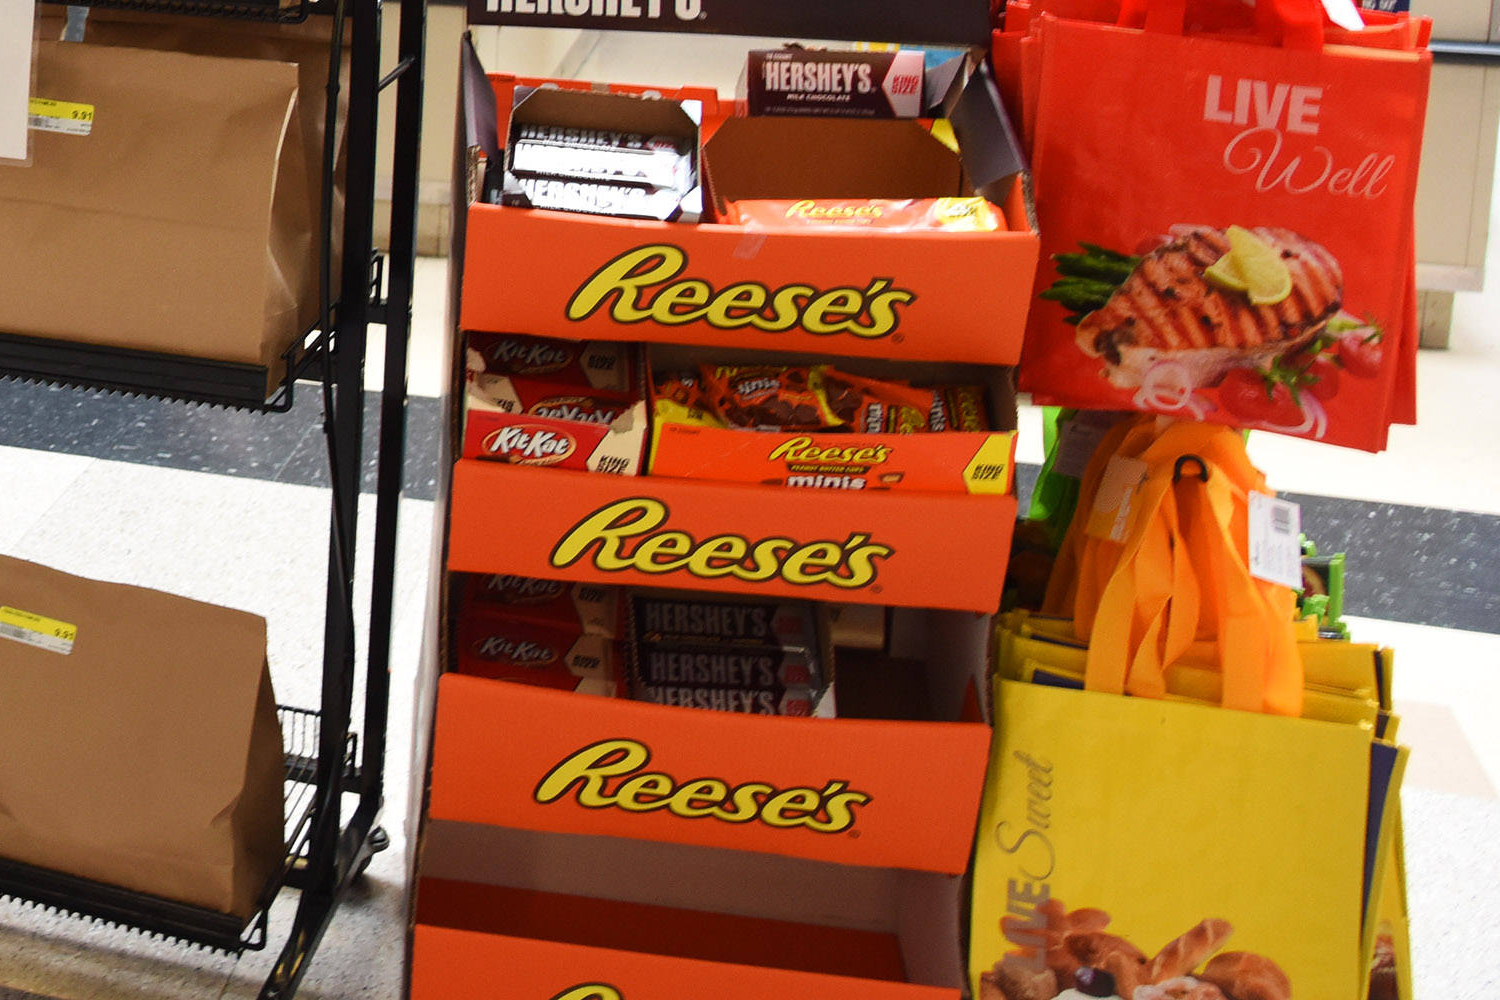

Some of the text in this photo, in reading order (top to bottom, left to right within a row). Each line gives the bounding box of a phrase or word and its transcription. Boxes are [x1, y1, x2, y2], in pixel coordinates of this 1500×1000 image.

[766, 62, 872, 94] HERSHEY'S
[891, 75, 919, 86] KING
[786, 93, 851, 103] MILK CHOCOLATE
[891, 85, 918, 95] SIZE
[72, 110, 93, 120] 9.91
[1203, 74, 1323, 136] LIVE
[520, 125, 642, 148] HERSHEY'S
[1222, 125, 1397, 200] Well
[785, 199, 883, 219] Reese's
[566, 242, 918, 339] Reese's
[599, 455, 629, 467] KING
[768, 436, 893, 464] Reese's
[790, 465, 817, 473] PEANUT
[844, 466, 864, 474] CUPS
[971, 471, 1003, 482] SIZE
[975, 463, 1005, 474] KING
[786, 473, 866, 491] minis
[550, 496, 895, 590] Reese's
[646, 602, 768, 637] HERSHEY'S
[54, 628, 75, 639] 9.91
[650, 653, 773, 685] HERSHEY'S
[534, 737, 872, 834] Reese's
[994, 749, 1056, 883] Sweet
[1004, 877, 1051, 972] LIVE
